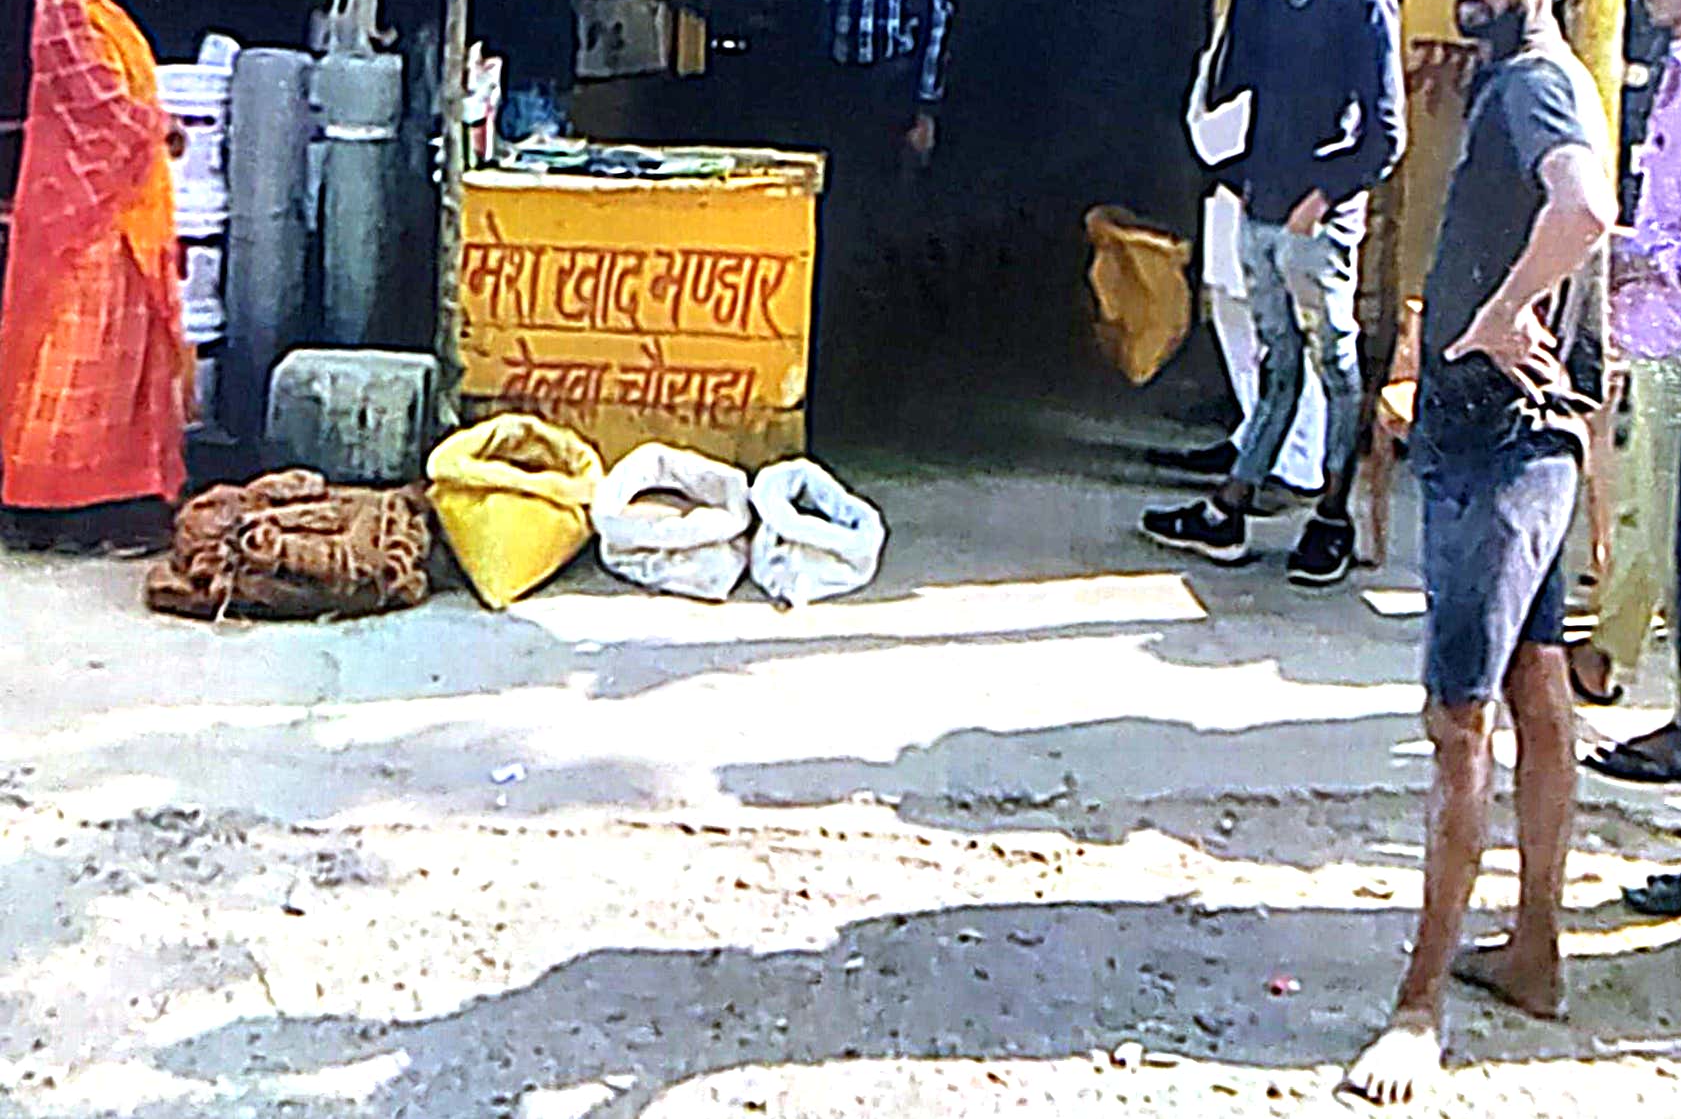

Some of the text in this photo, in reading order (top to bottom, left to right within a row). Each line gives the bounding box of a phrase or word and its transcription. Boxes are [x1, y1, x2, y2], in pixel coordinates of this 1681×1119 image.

[551, 245, 647, 331] खाद
[651, 248, 796, 339] भण्डार
[614, 337, 756, 430] चौराहा
